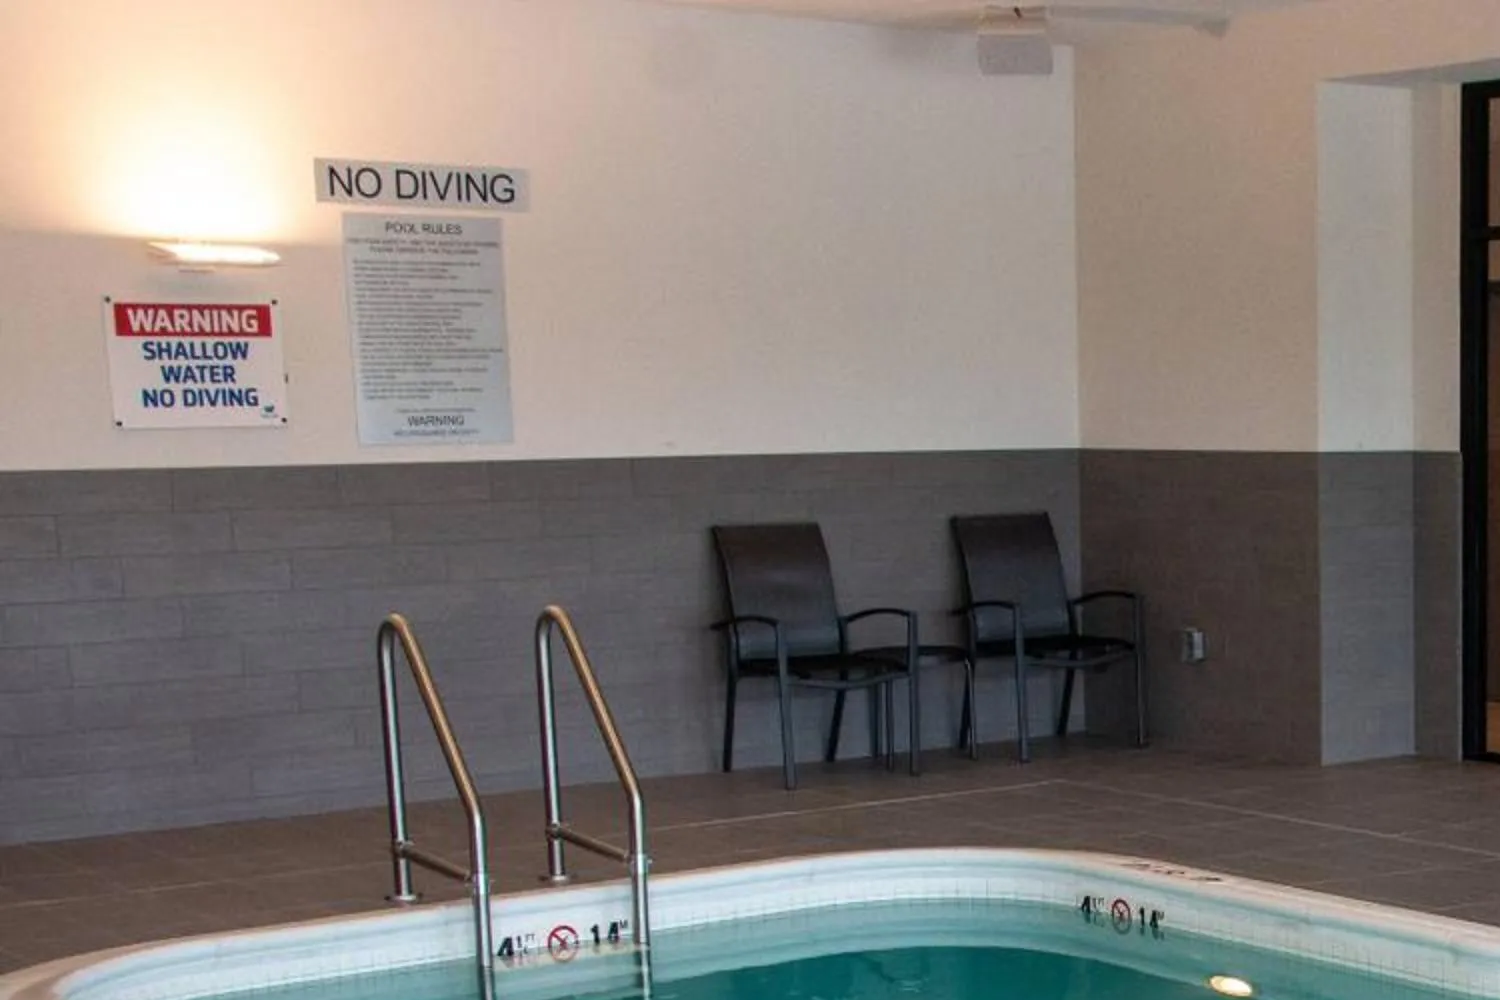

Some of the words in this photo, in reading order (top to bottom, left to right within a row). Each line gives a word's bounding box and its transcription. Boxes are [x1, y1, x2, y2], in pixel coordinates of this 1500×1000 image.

[328, 165, 382, 199] NO
[395, 168, 516, 204] DIVING
[385, 221, 417, 235] POOL
[421, 222, 463, 236] RULES
[127, 308, 259, 334] WARNING
[141, 340, 250, 361] SHALLOW
[160, 364, 237, 385] WATER
[142, 388, 176, 408] NO
[182, 387, 260, 408] DIVING
